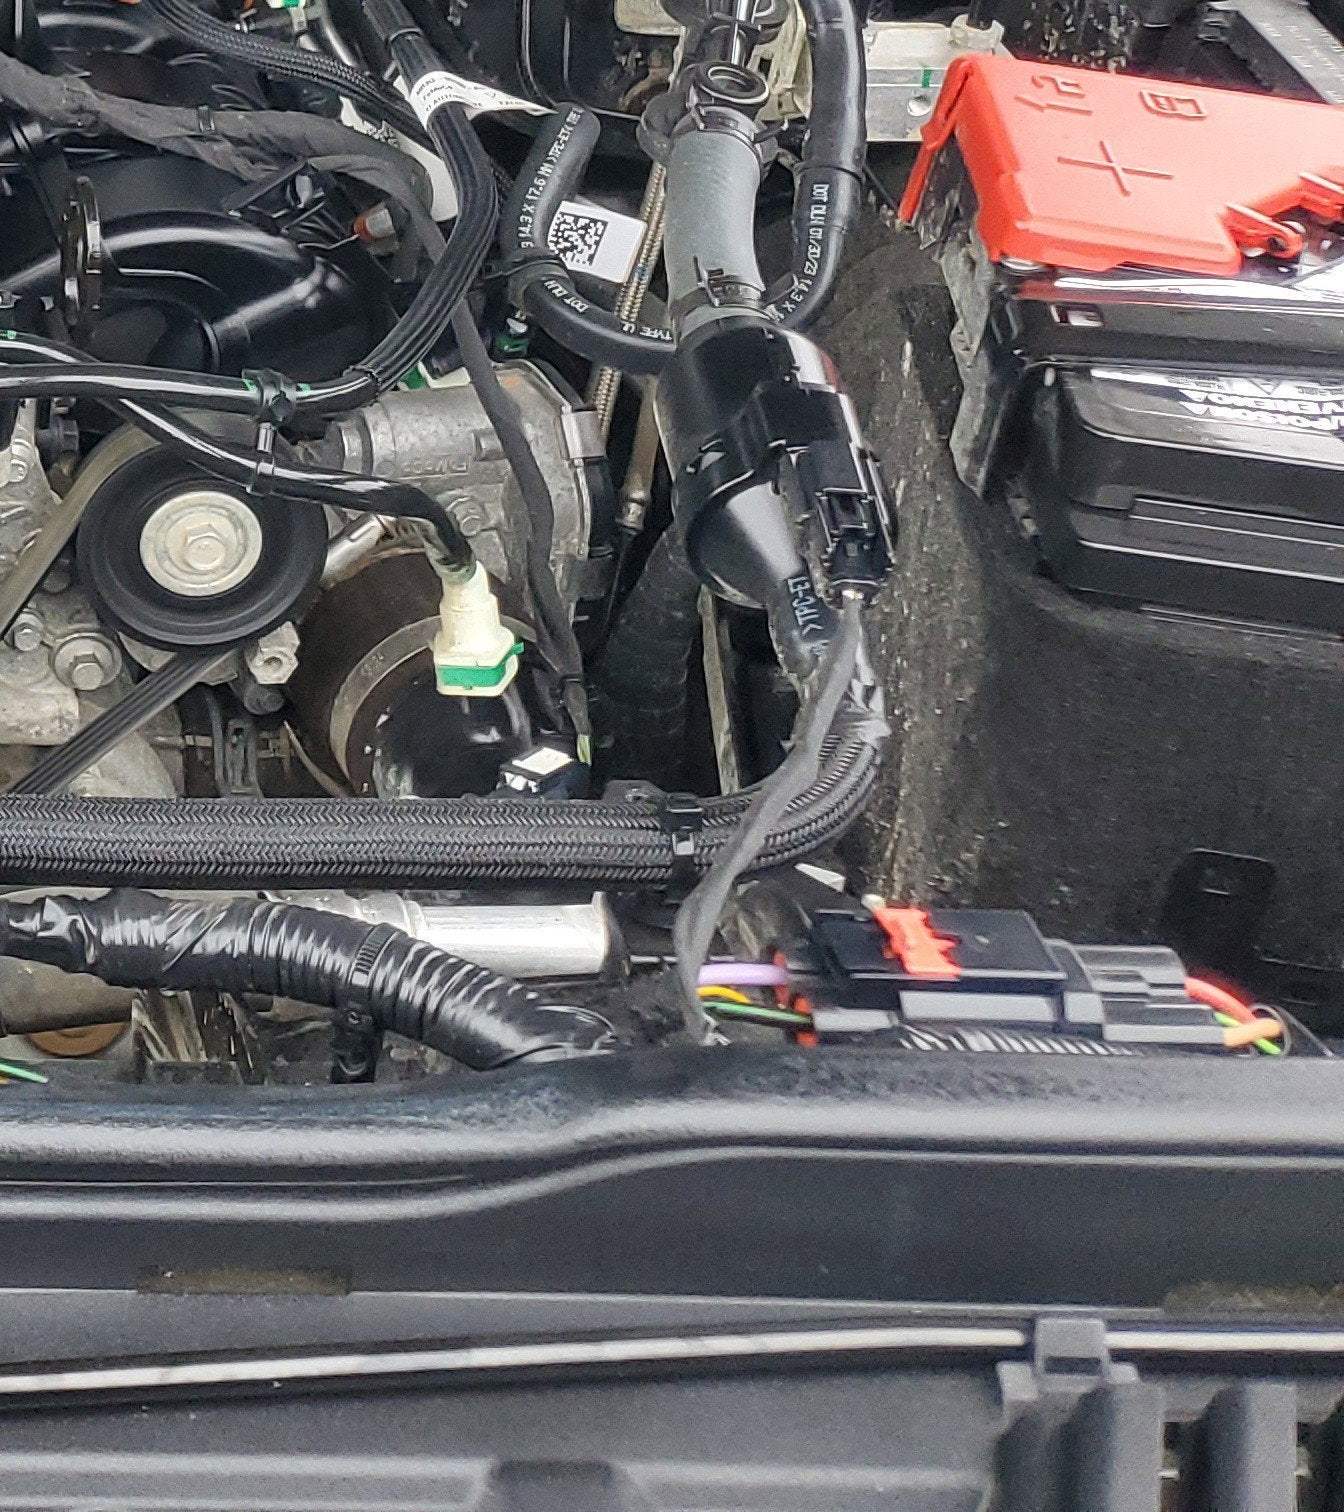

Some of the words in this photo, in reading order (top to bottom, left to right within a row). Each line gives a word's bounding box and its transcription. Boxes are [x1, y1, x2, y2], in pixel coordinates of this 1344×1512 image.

[813, 184, 829, 202] DOT
[522, 203, 535, 213] X
[804, 228, 823, 276] 01/30/23
[563, 296, 588, 313] DOT
[782, 301, 796, 312] X
[640, 326, 671, 340] TYPE
